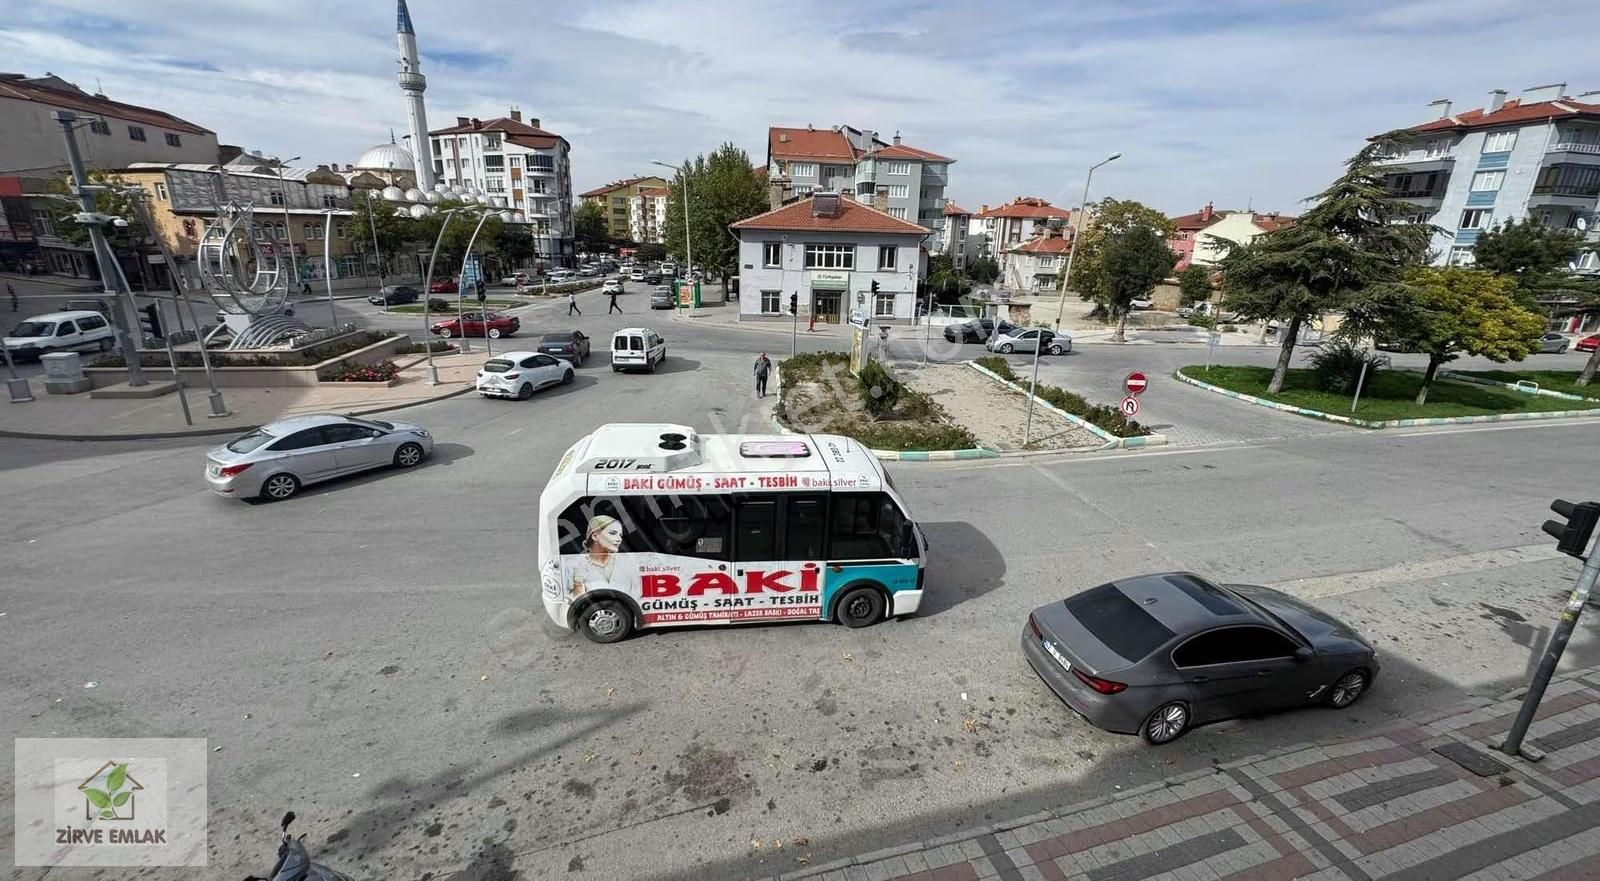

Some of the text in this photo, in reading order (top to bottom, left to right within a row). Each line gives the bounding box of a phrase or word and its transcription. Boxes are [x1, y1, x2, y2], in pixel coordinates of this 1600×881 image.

[594, 458, 637, 469] 2017
[623, 475, 653, 490] BAKİ
[657, 475, 702, 491] GÜMÜŞ
[714, 477, 747, 489] SAAT
[758, 474, 797, 488] TESBİH
[640, 562, 819, 598] BAKİ
[641, 597, 698, 611] GÜMÜŞ
[714, 597, 755, 608] SAAT
[769, 593, 819, 605] TESBİH
